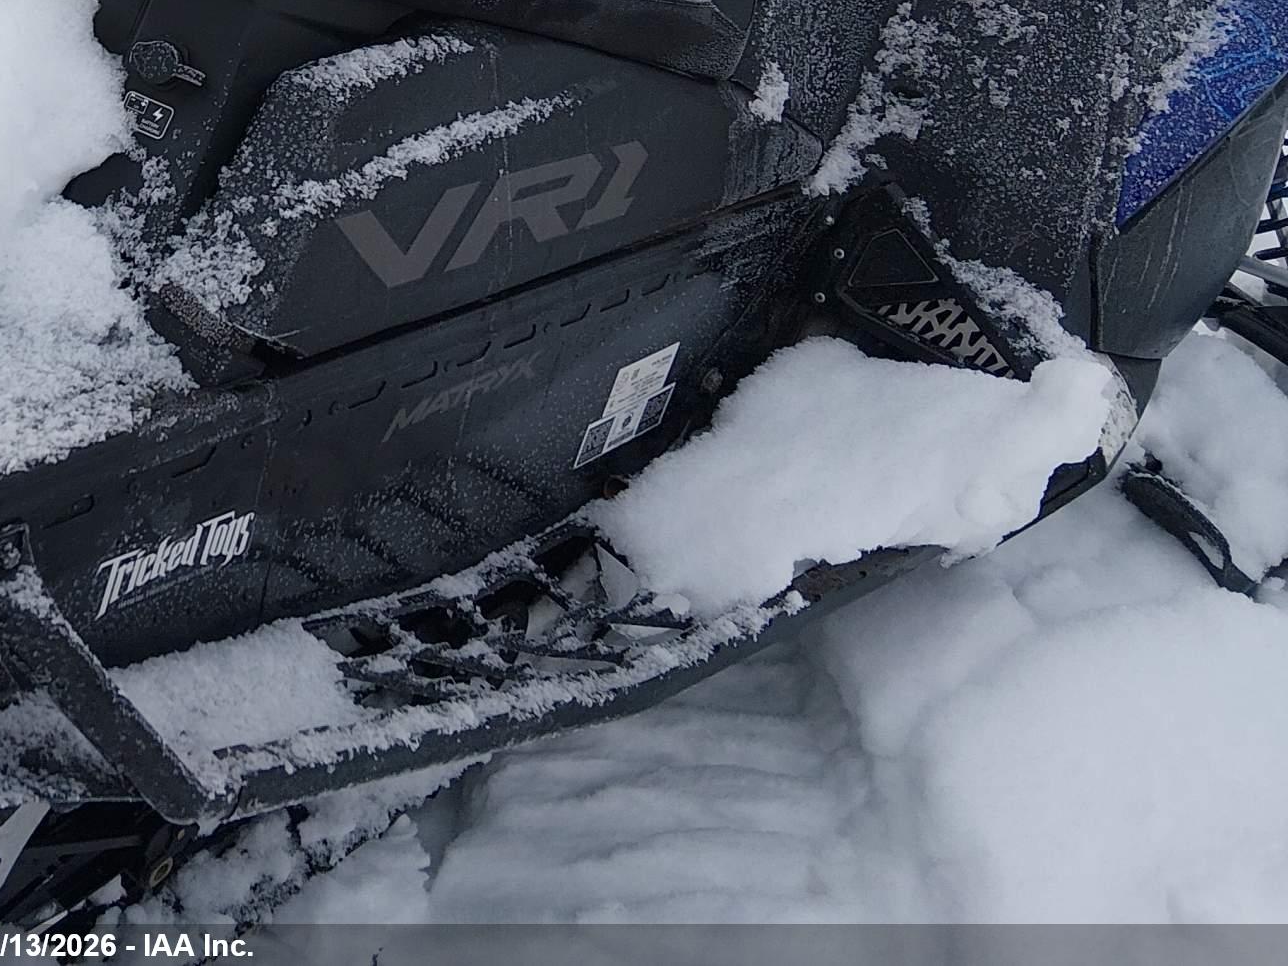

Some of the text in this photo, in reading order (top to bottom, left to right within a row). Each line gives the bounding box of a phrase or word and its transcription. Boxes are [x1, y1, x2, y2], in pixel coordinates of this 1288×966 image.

[335, 140, 649, 289] VR1
[94, 523, 204, 621] Tricked
[199, 510, 255, 570] Toys
